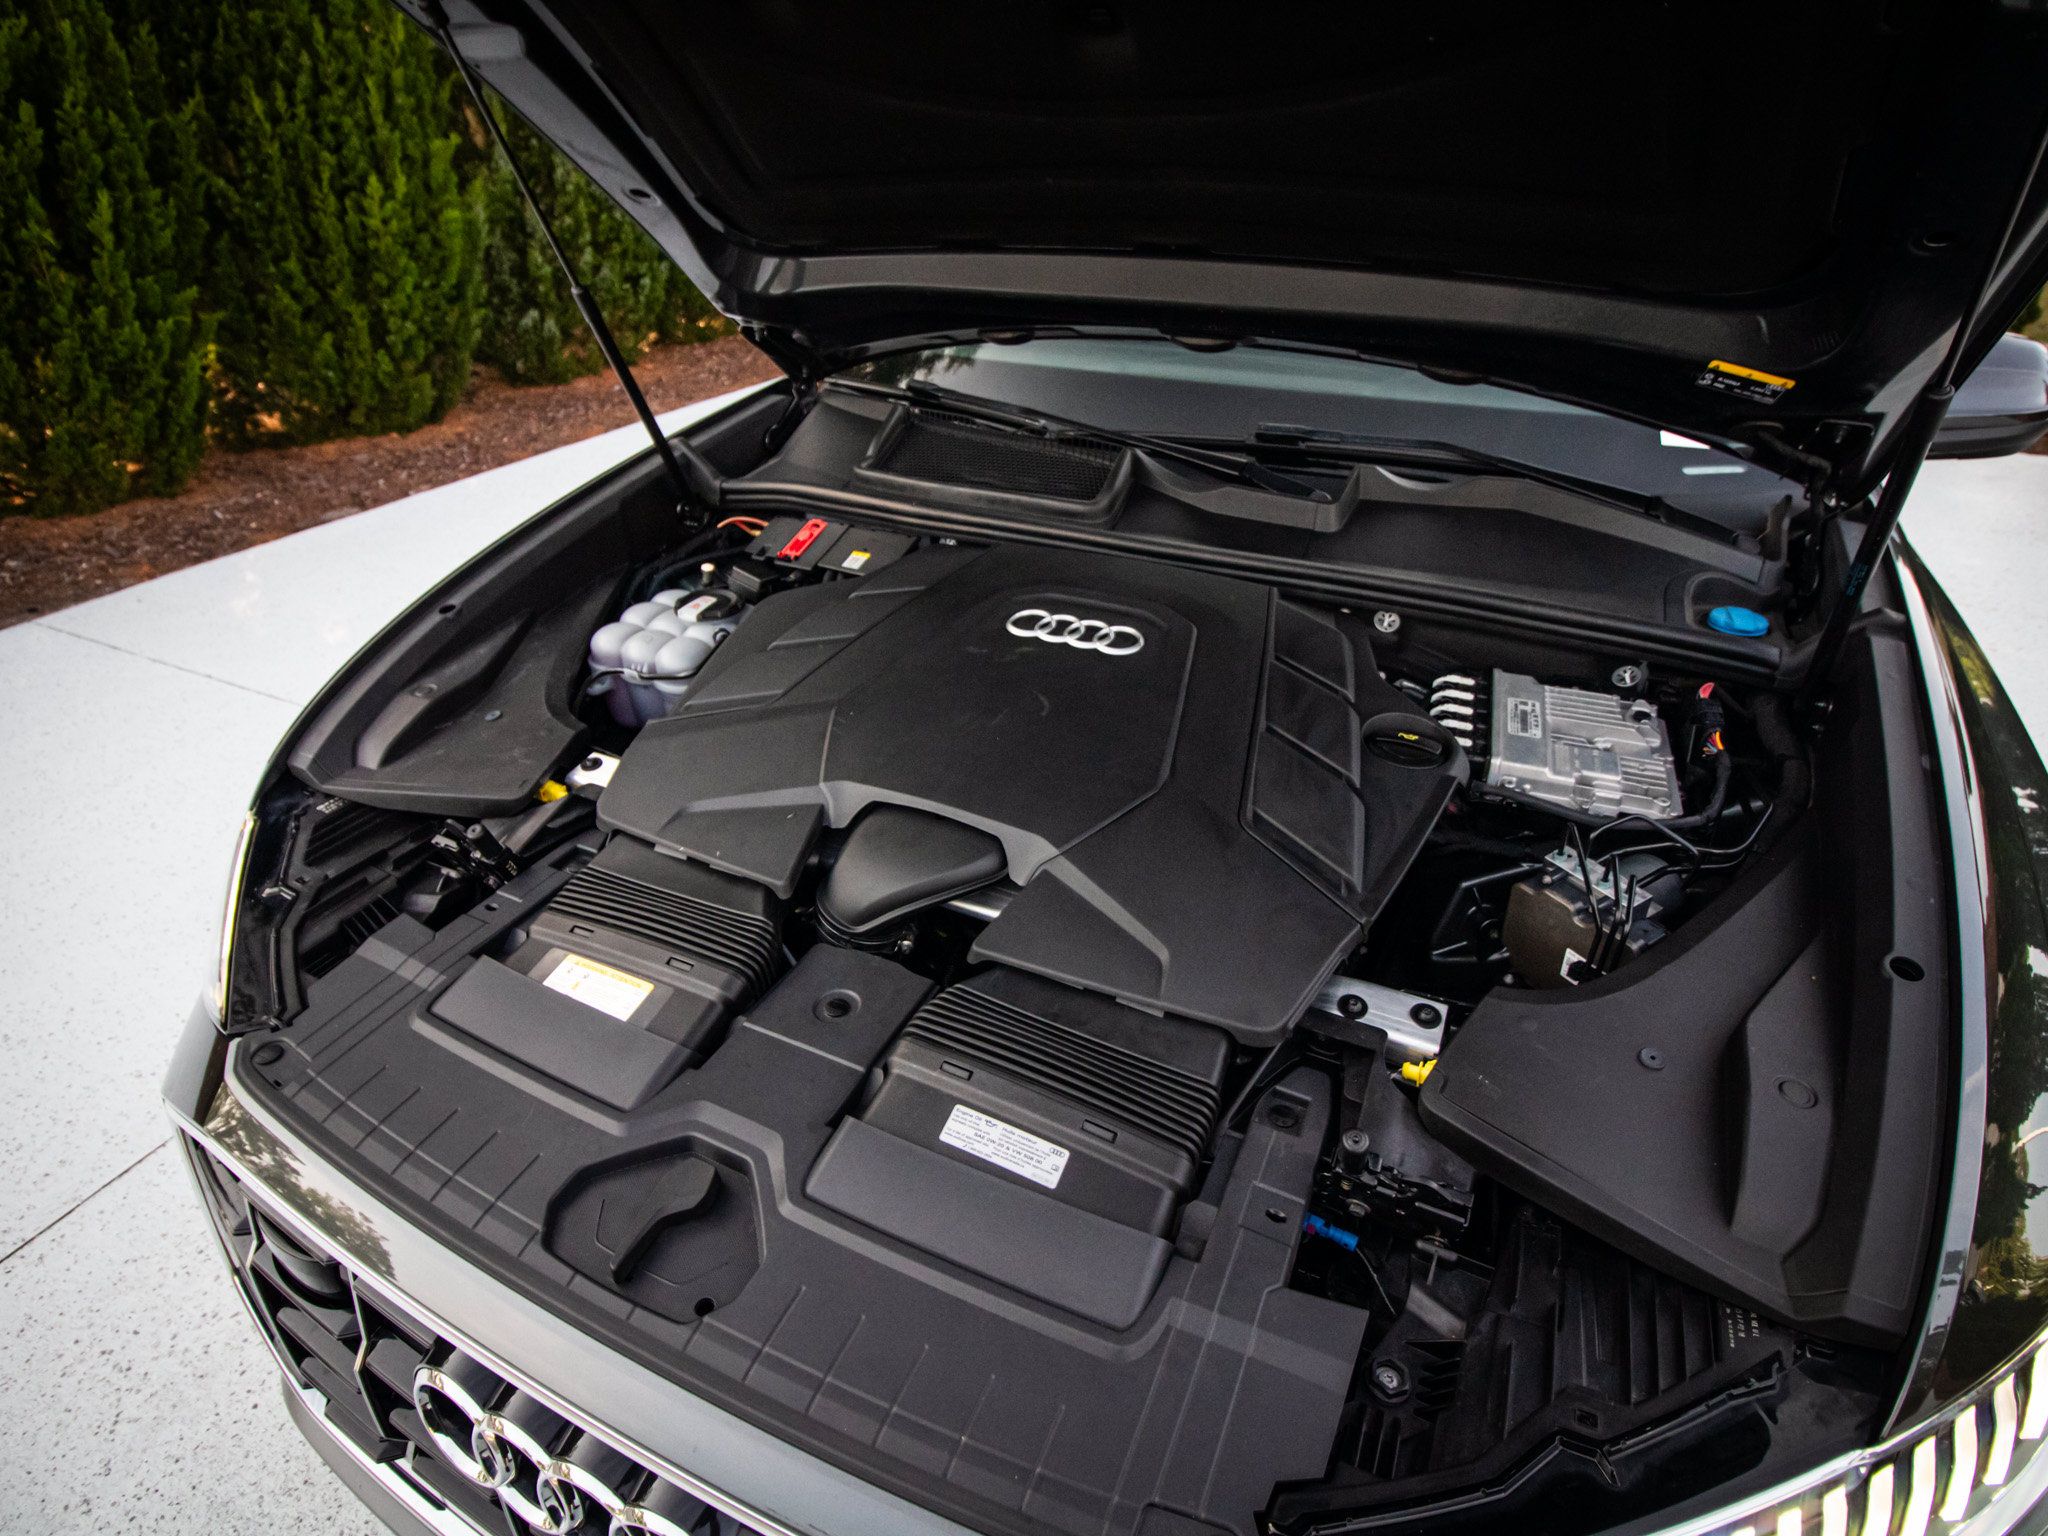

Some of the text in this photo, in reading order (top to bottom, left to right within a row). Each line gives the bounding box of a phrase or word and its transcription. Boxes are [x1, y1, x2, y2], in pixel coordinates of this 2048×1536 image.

[956, 1108, 974, 1118] Engine
[973, 1132, 985, 1140] SAE
[1011, 1148, 1022, 1156] VW
[1016, 1133, 1038, 1145] moteur
